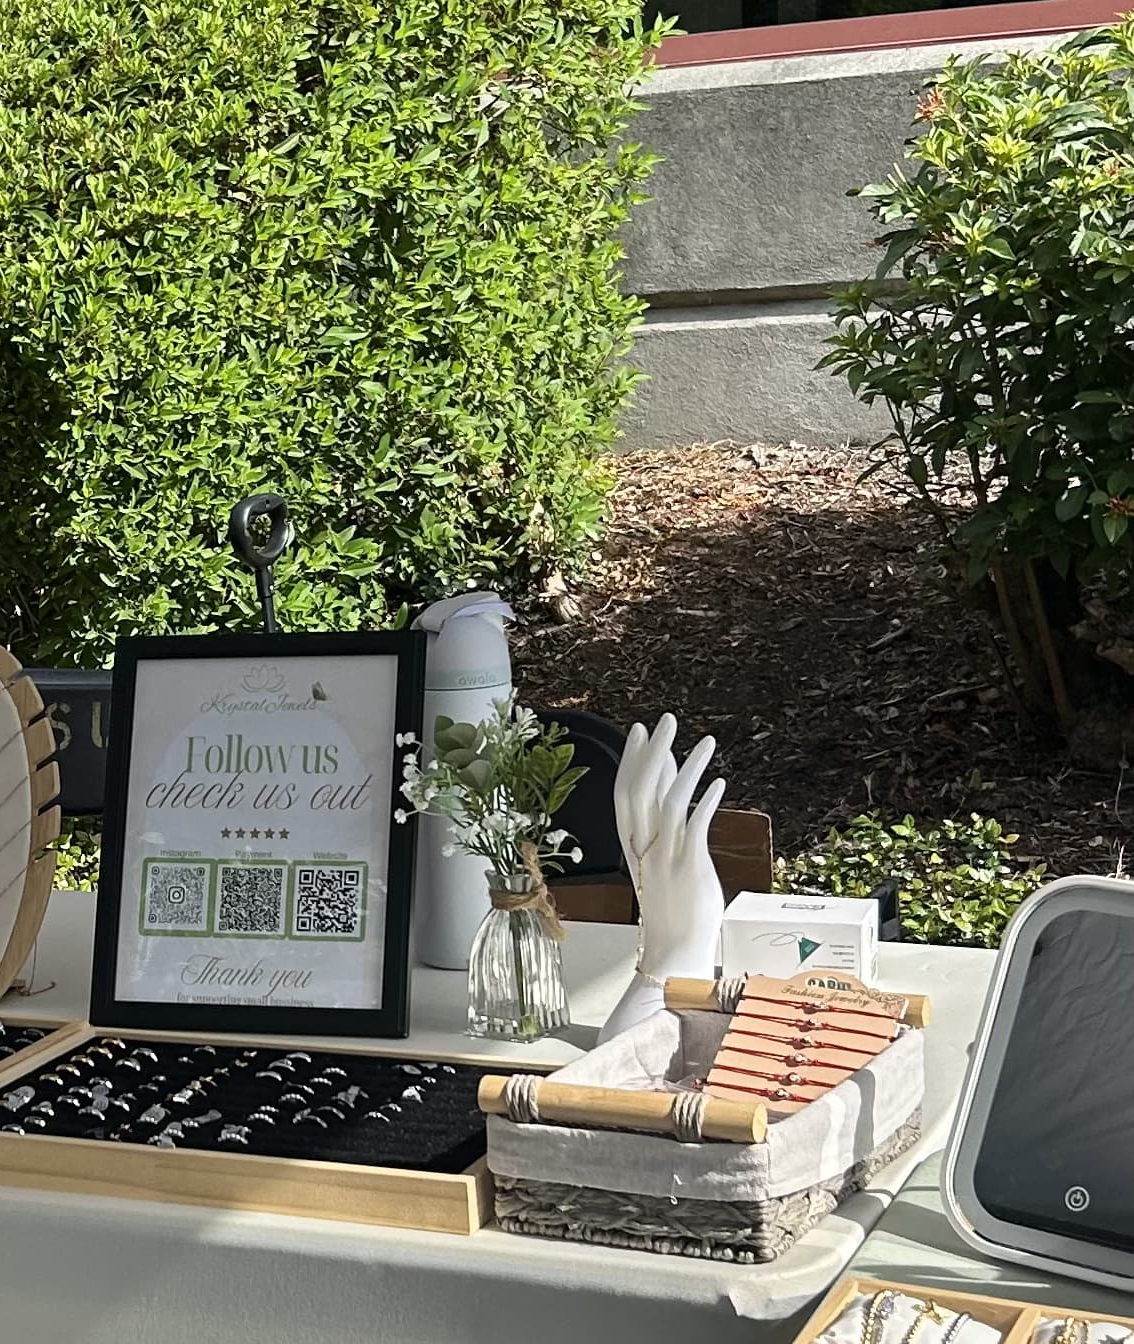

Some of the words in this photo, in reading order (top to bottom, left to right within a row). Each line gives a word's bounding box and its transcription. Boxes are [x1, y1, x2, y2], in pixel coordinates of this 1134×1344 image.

[200, 693, 266, 717] Krystal
[185, 734, 295, 774] Follow
[301, 743, 339, 775] us
[145, 770, 244, 809] check
[253, 782, 300, 810] us
[310, 773, 373, 810] out
[180, 954, 264, 986] Thank
[264, 968, 313, 998] you
